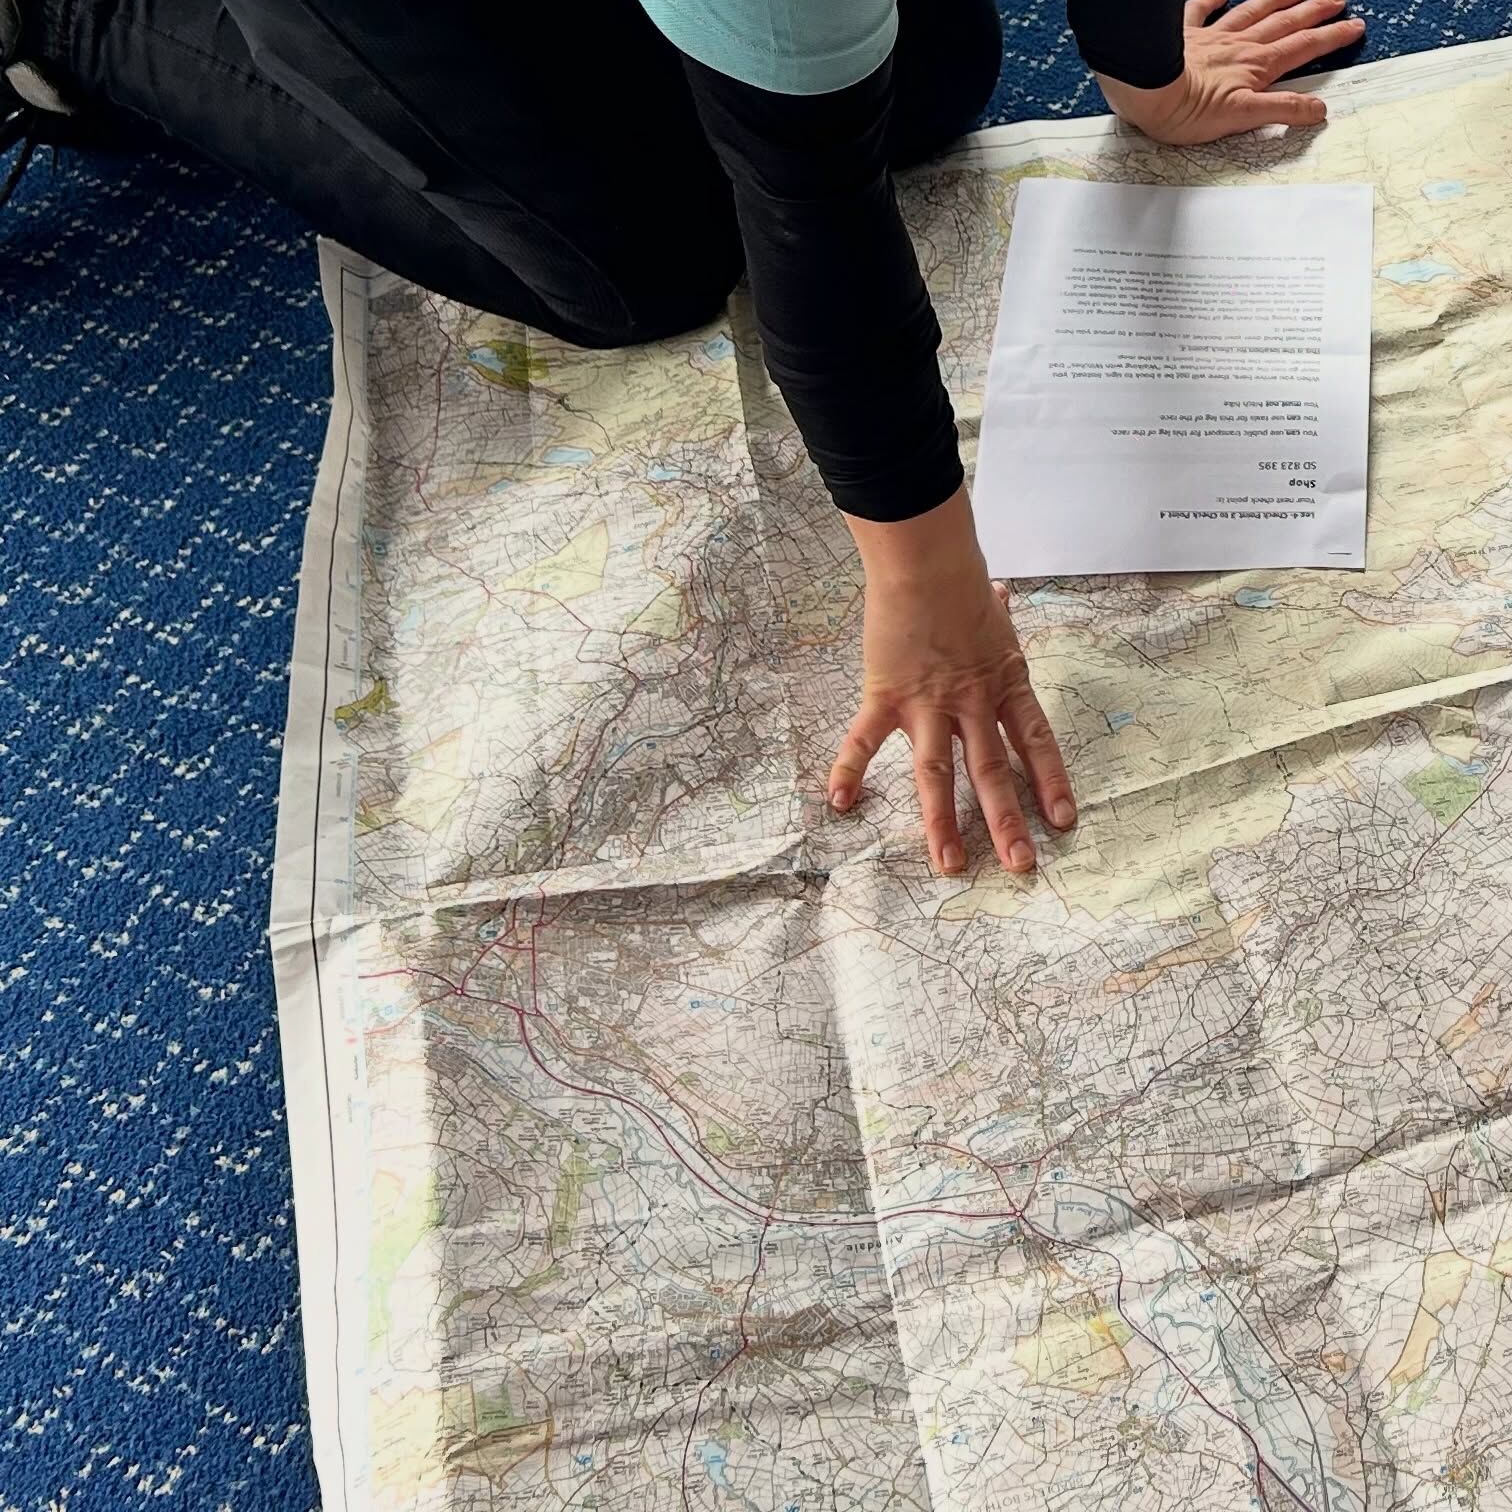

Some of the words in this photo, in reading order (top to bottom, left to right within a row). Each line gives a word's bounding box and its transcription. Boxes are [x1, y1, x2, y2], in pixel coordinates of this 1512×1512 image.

[1205, 414, 1217, 422] leg
[1158, 429, 1170, 437] leg
[1243, 429, 1268, 437] public
[1258, 461, 1278, 470] 395
[1281, 461, 1300, 470] 823
[1303, 461, 1317, 470] SD
[1289, 478, 1316, 488] Shop
[1226, 496, 1248, 504] point
[1160, 511, 1165, 519] 4
[1168, 511, 1190, 519] Point
[1193, 511, 1218, 519] Check
[1220, 511, 1228, 519] to
[1239, 511, 1260, 519] Point
[1263, 511, 1288, 519] Check
